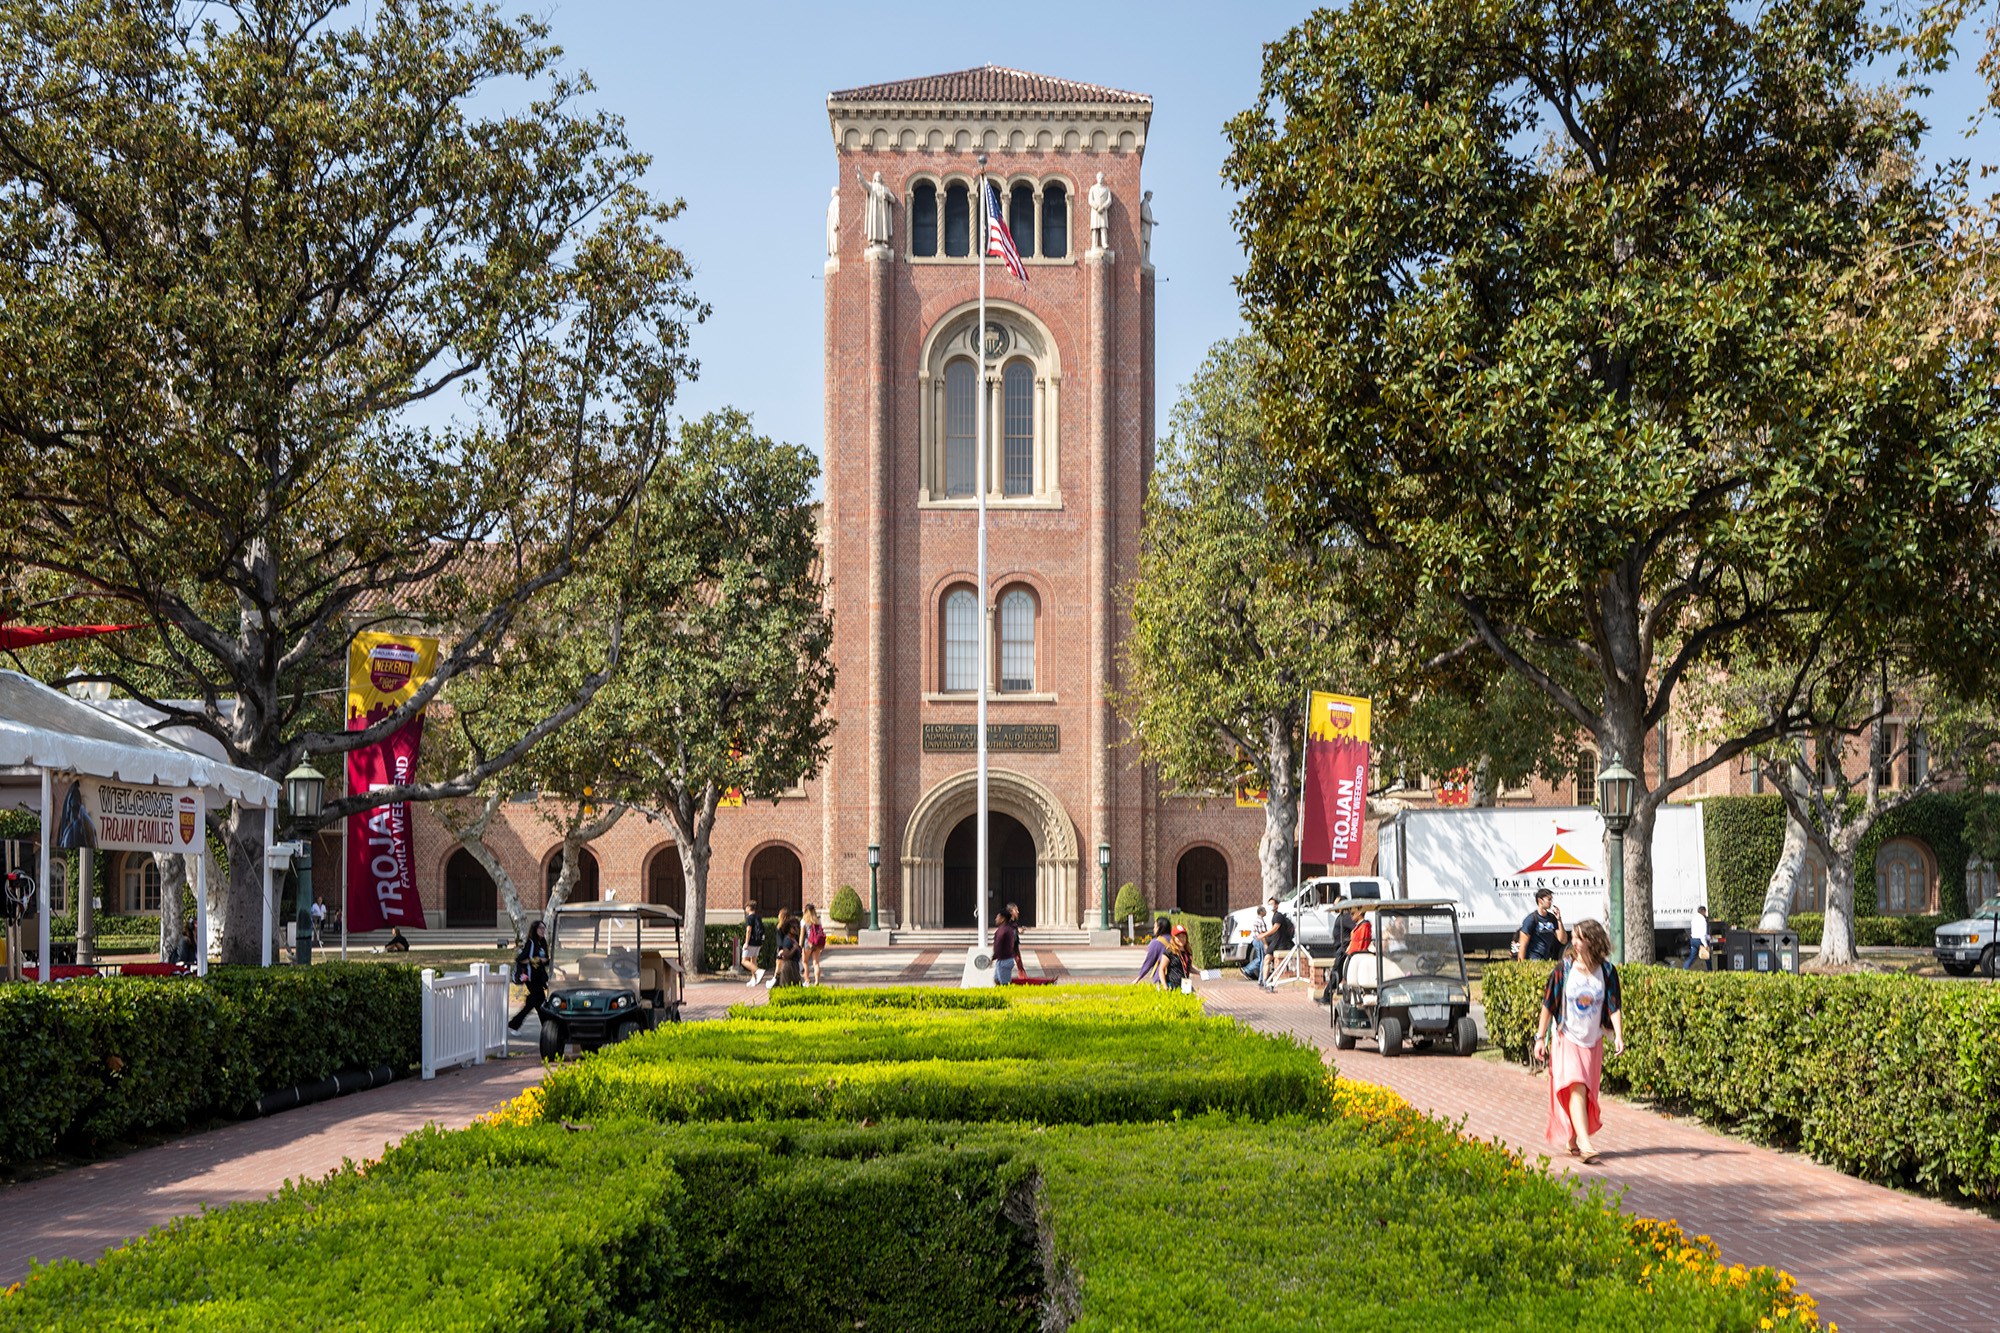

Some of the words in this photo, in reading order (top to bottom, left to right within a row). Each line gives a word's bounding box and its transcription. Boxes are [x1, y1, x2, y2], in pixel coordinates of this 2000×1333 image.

[374, 659, 410, 676] WEEKEND
[925, 725, 954, 733] GEORGE
[1024, 725, 1055, 733] BOVARD
[925, 733, 978, 741] ADMINISTRATI
[1003, 733, 1055, 741] AUDITORIUM
[925, 741, 961, 749] UNIVERSITY
[987, 741, 1013, 749] UTHERN
[1018, 741, 1055, 749] CALIFORNIA
[98, 785, 174, 819] WELCOME
[391, 755, 409, 834] WEEEND
[1353, 765, 1364, 810] WEEKEND
[100, 816, 136, 843] TROJAN
[137, 818, 174, 845] FAMILIES
[1332, 779, 1355, 861] TROJAN
[1350, 812, 1360, 842] FAMILY
[393, 838, 410, 889] FAMILY
[1493, 877, 1530, 888] Town
[1536, 877, 1546, 887] &
[1552, 876, 1604, 887] Count
